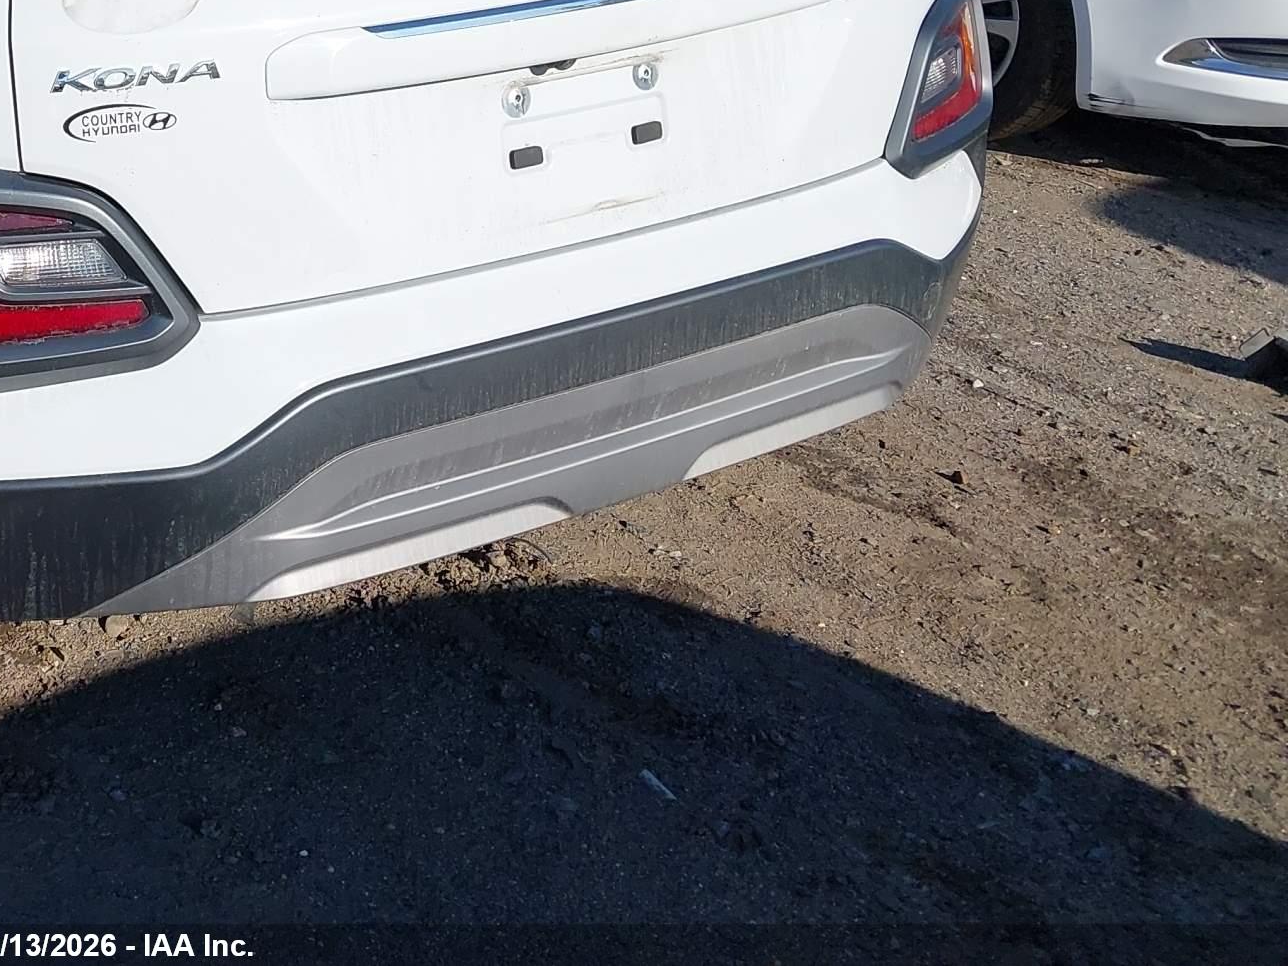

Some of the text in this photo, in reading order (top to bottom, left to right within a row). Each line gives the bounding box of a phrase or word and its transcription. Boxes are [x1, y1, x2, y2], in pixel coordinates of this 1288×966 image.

[50, 59, 221, 94] KONA
[81, 111, 142, 127] COUNTRY
[82, 124, 141, 138] HYUNDAI
